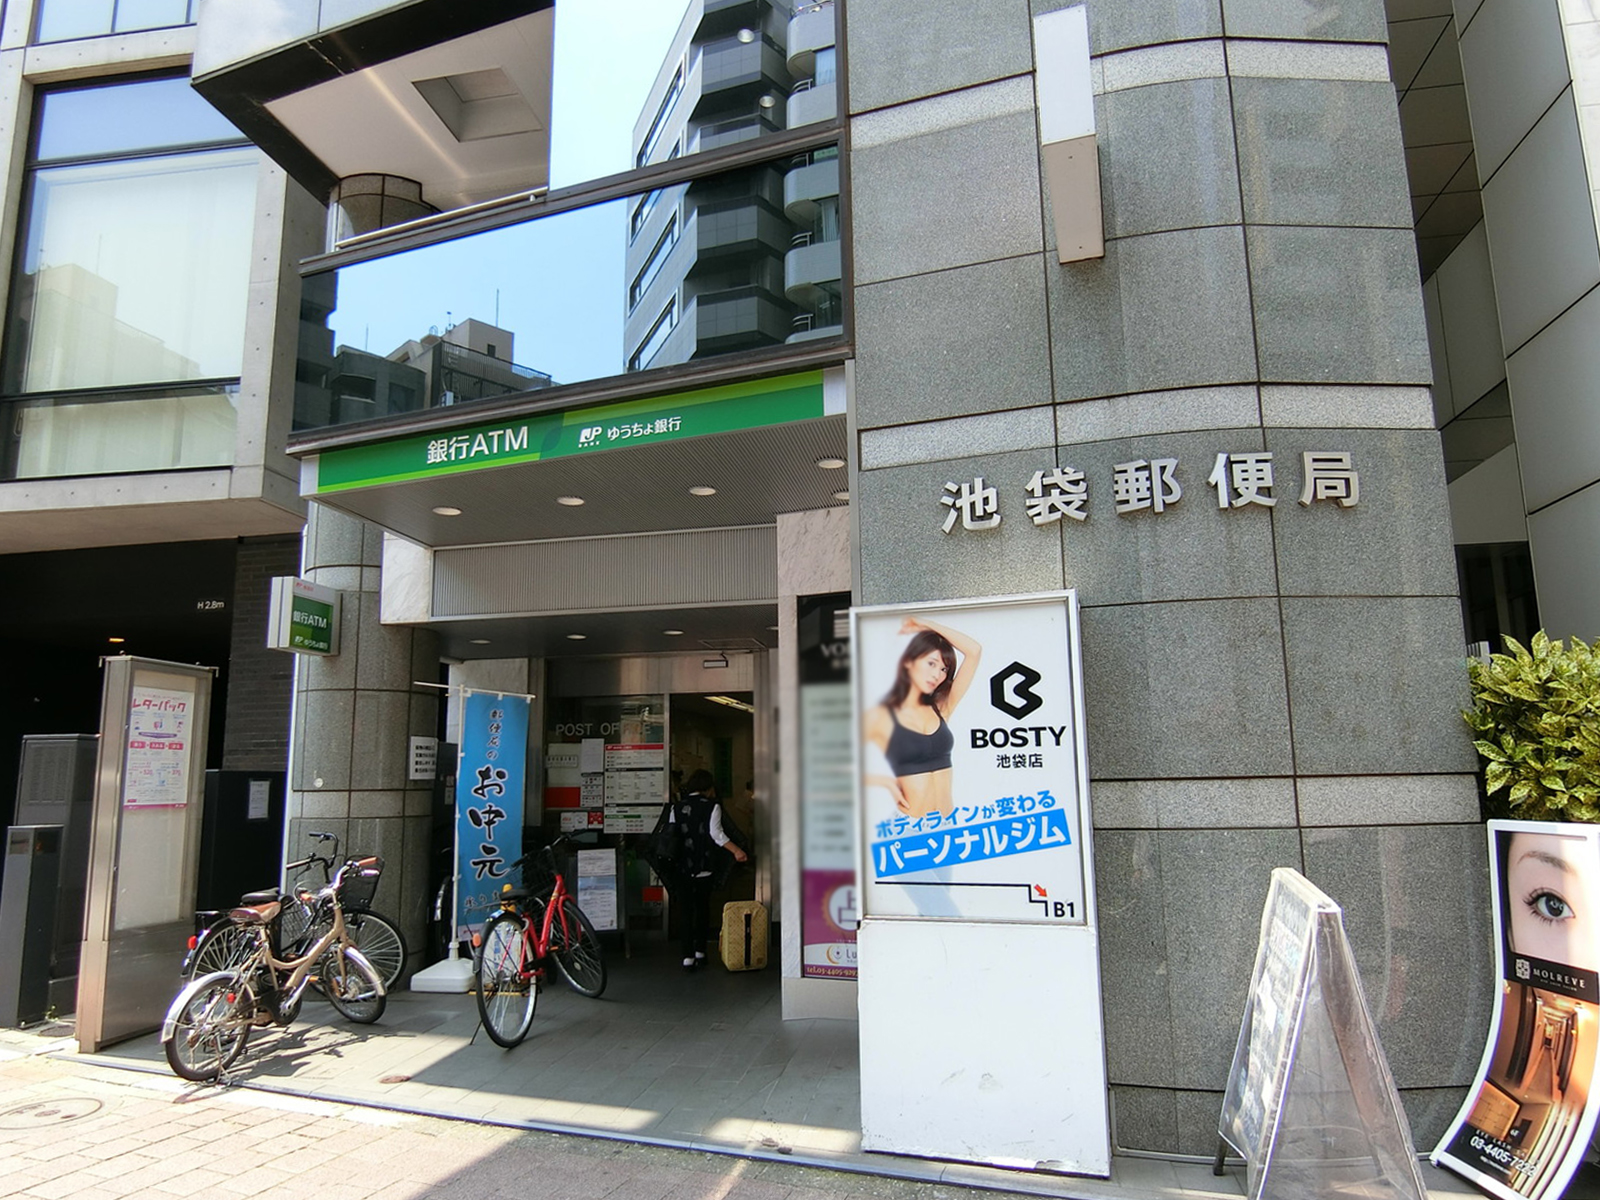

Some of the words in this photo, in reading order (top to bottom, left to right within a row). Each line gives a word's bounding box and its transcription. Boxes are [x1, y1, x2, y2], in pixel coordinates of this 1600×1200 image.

[607, 416, 682, 441] ゆうちょ銀行
[427, 426, 528, 464] 銀行ATM
[940, 450, 1361, 535] 池袋郵便局
[197, 601, 204, 610] H
[205, 600, 225, 609] 2.8m
[293, 610, 328, 629] 銀行ATM
[132, 698, 187, 713] レターパック
[556, 723, 593, 737] POST
[970, 726, 1066, 749] BOSTY
[996, 753, 1043, 769] 池袋店
[468, 763, 509, 879] お中元
[875, 790, 1057, 839] ボディラインが変わる
[878, 815, 1066, 873] パーソナルジム
[1053, 902, 1075, 918] B1
[1533, 967, 1586, 989] MOLREVE
[1509, 1128, 1520, 1137] 6F
[1470, 1135, 1537, 1178] 03-4405-7222
